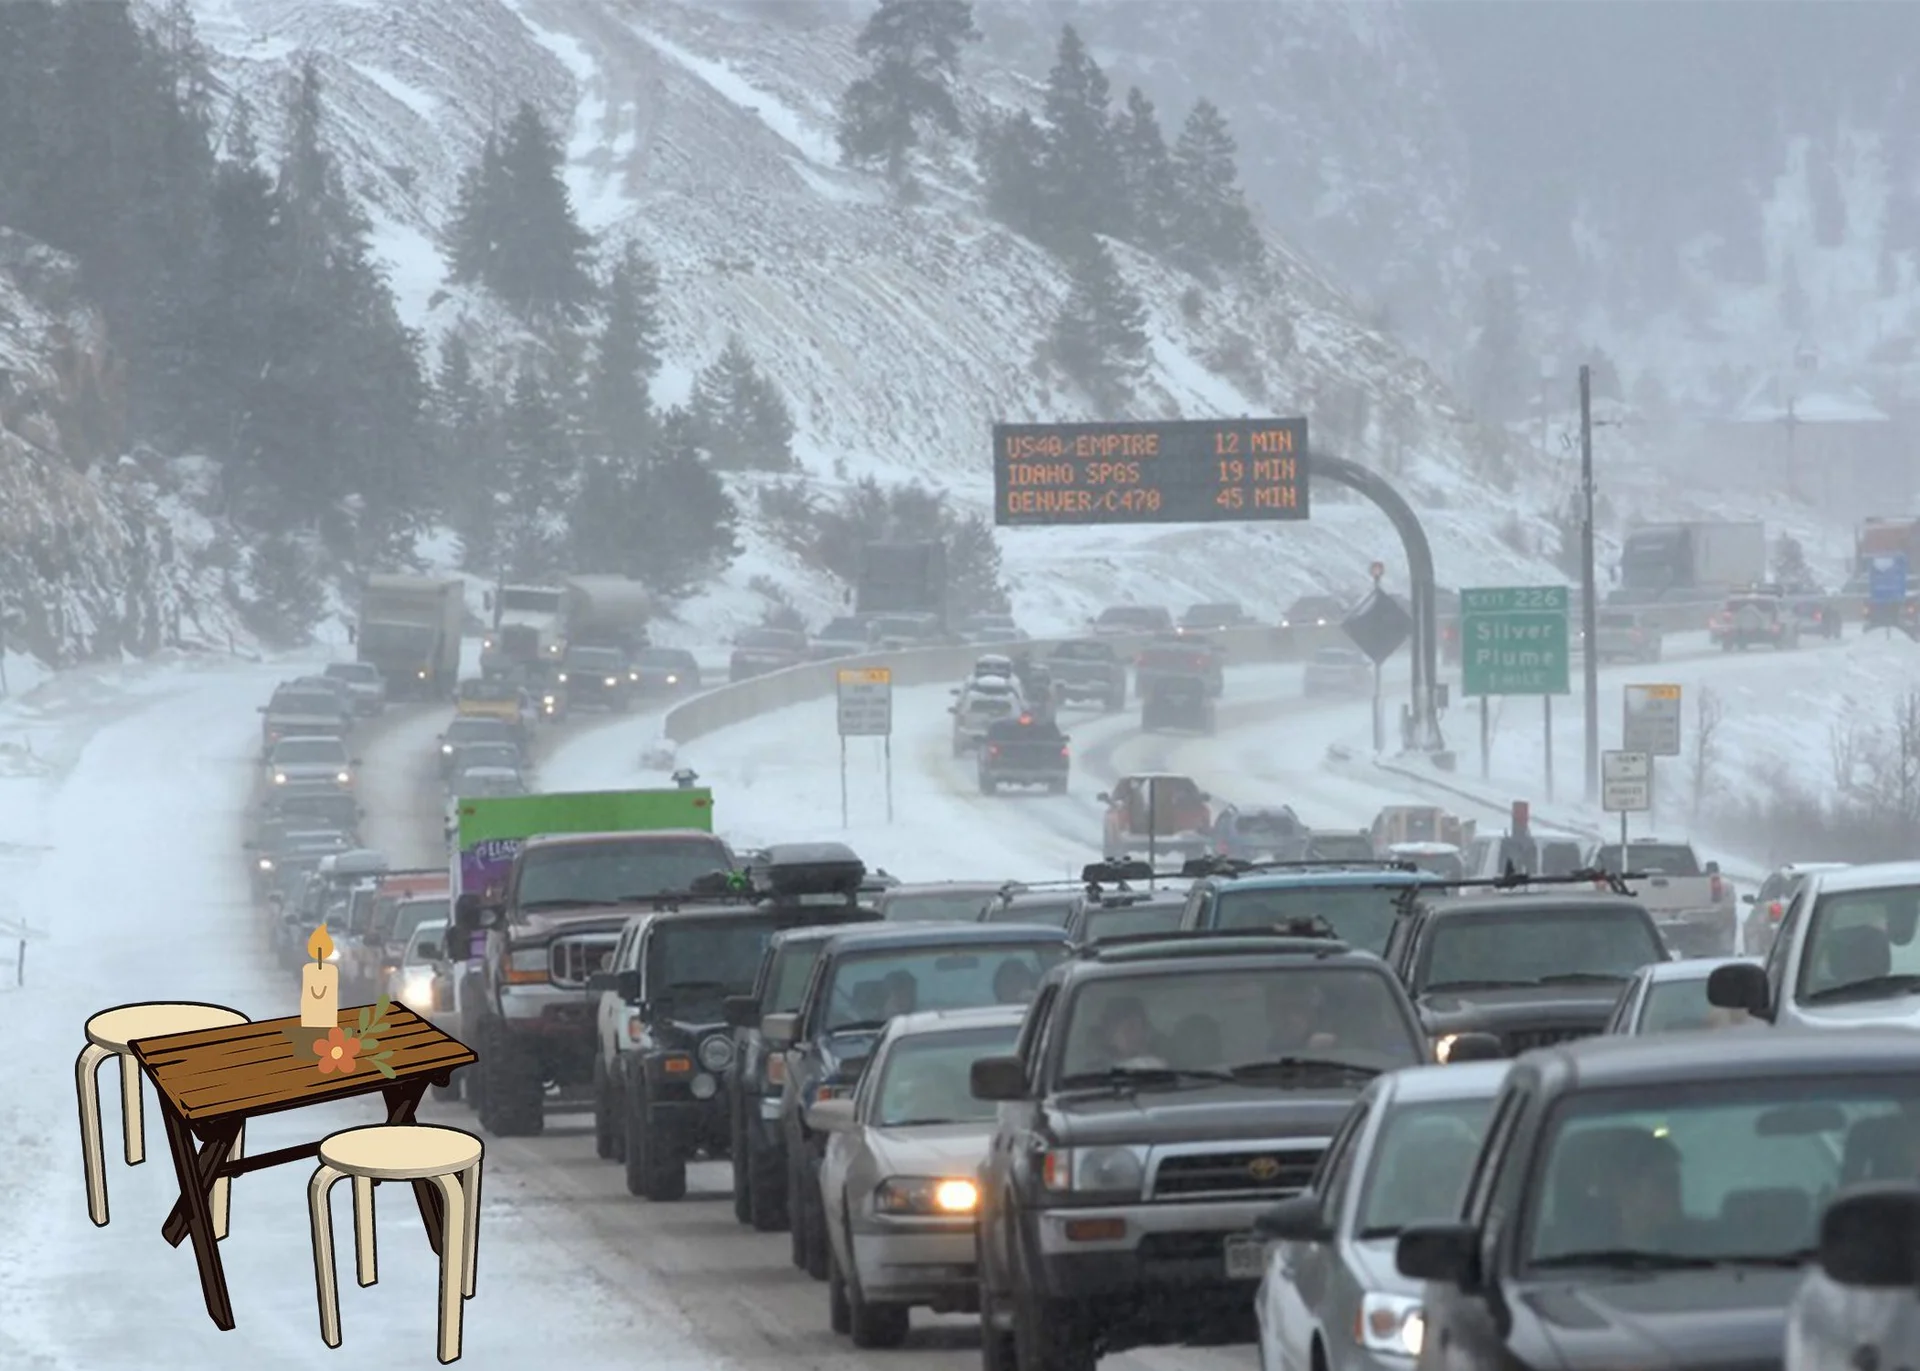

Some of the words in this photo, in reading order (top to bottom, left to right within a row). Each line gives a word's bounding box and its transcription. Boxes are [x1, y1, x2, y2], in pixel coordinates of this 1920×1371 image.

[1006, 434, 1159, 458] US40/EMPIRE
[1215, 432, 1239, 454] 12
[1251, 429, 1292, 453] MIN
[1008, 464, 1074, 486] IDAHO
[1086, 462, 1140, 484] SPGS
[1218, 460, 1243, 482] 19
[1254, 459, 1296, 480] MIN
[1008, 489, 1161, 513] DENVER/C470
[1216, 487, 1243, 509] 45
[1255, 486, 1297, 508] MIN
[1514, 589, 1559, 606] 226
[1476, 621, 1553, 641] Silver
[1475, 649, 1554, 667] Plume
